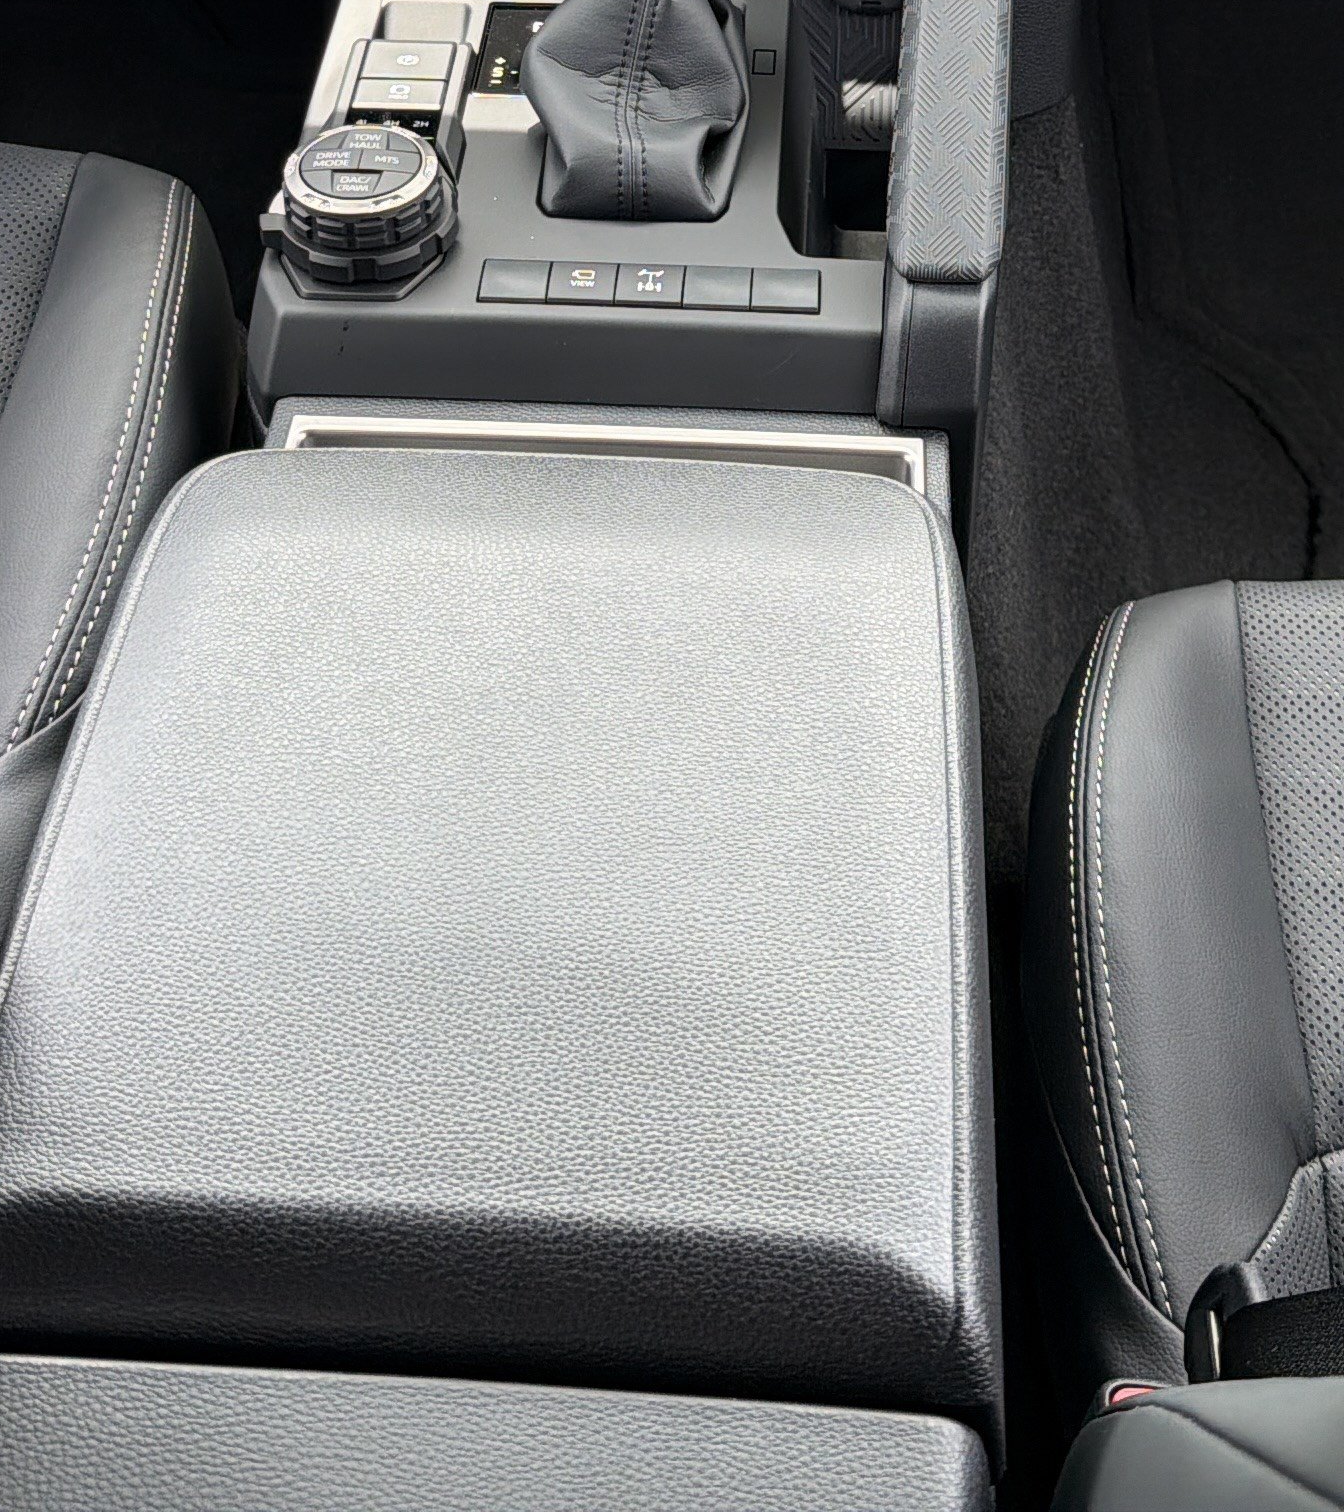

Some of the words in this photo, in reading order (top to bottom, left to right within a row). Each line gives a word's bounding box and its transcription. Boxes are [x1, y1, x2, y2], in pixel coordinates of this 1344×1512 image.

[490, 67, 504, 77] S
[412, 120, 430, 128] 2H
[355, 133, 382, 142] TOW
[349, 141, 382, 149] HAUL
[315, 150, 352, 160] DRIVE
[312, 159, 349, 168] MODE
[374, 155, 400, 165] MTS
[339, 175, 370, 184] DAC/
[335, 184, 369, 193] CRAWL
[570, 279, 596, 288] VIEW
